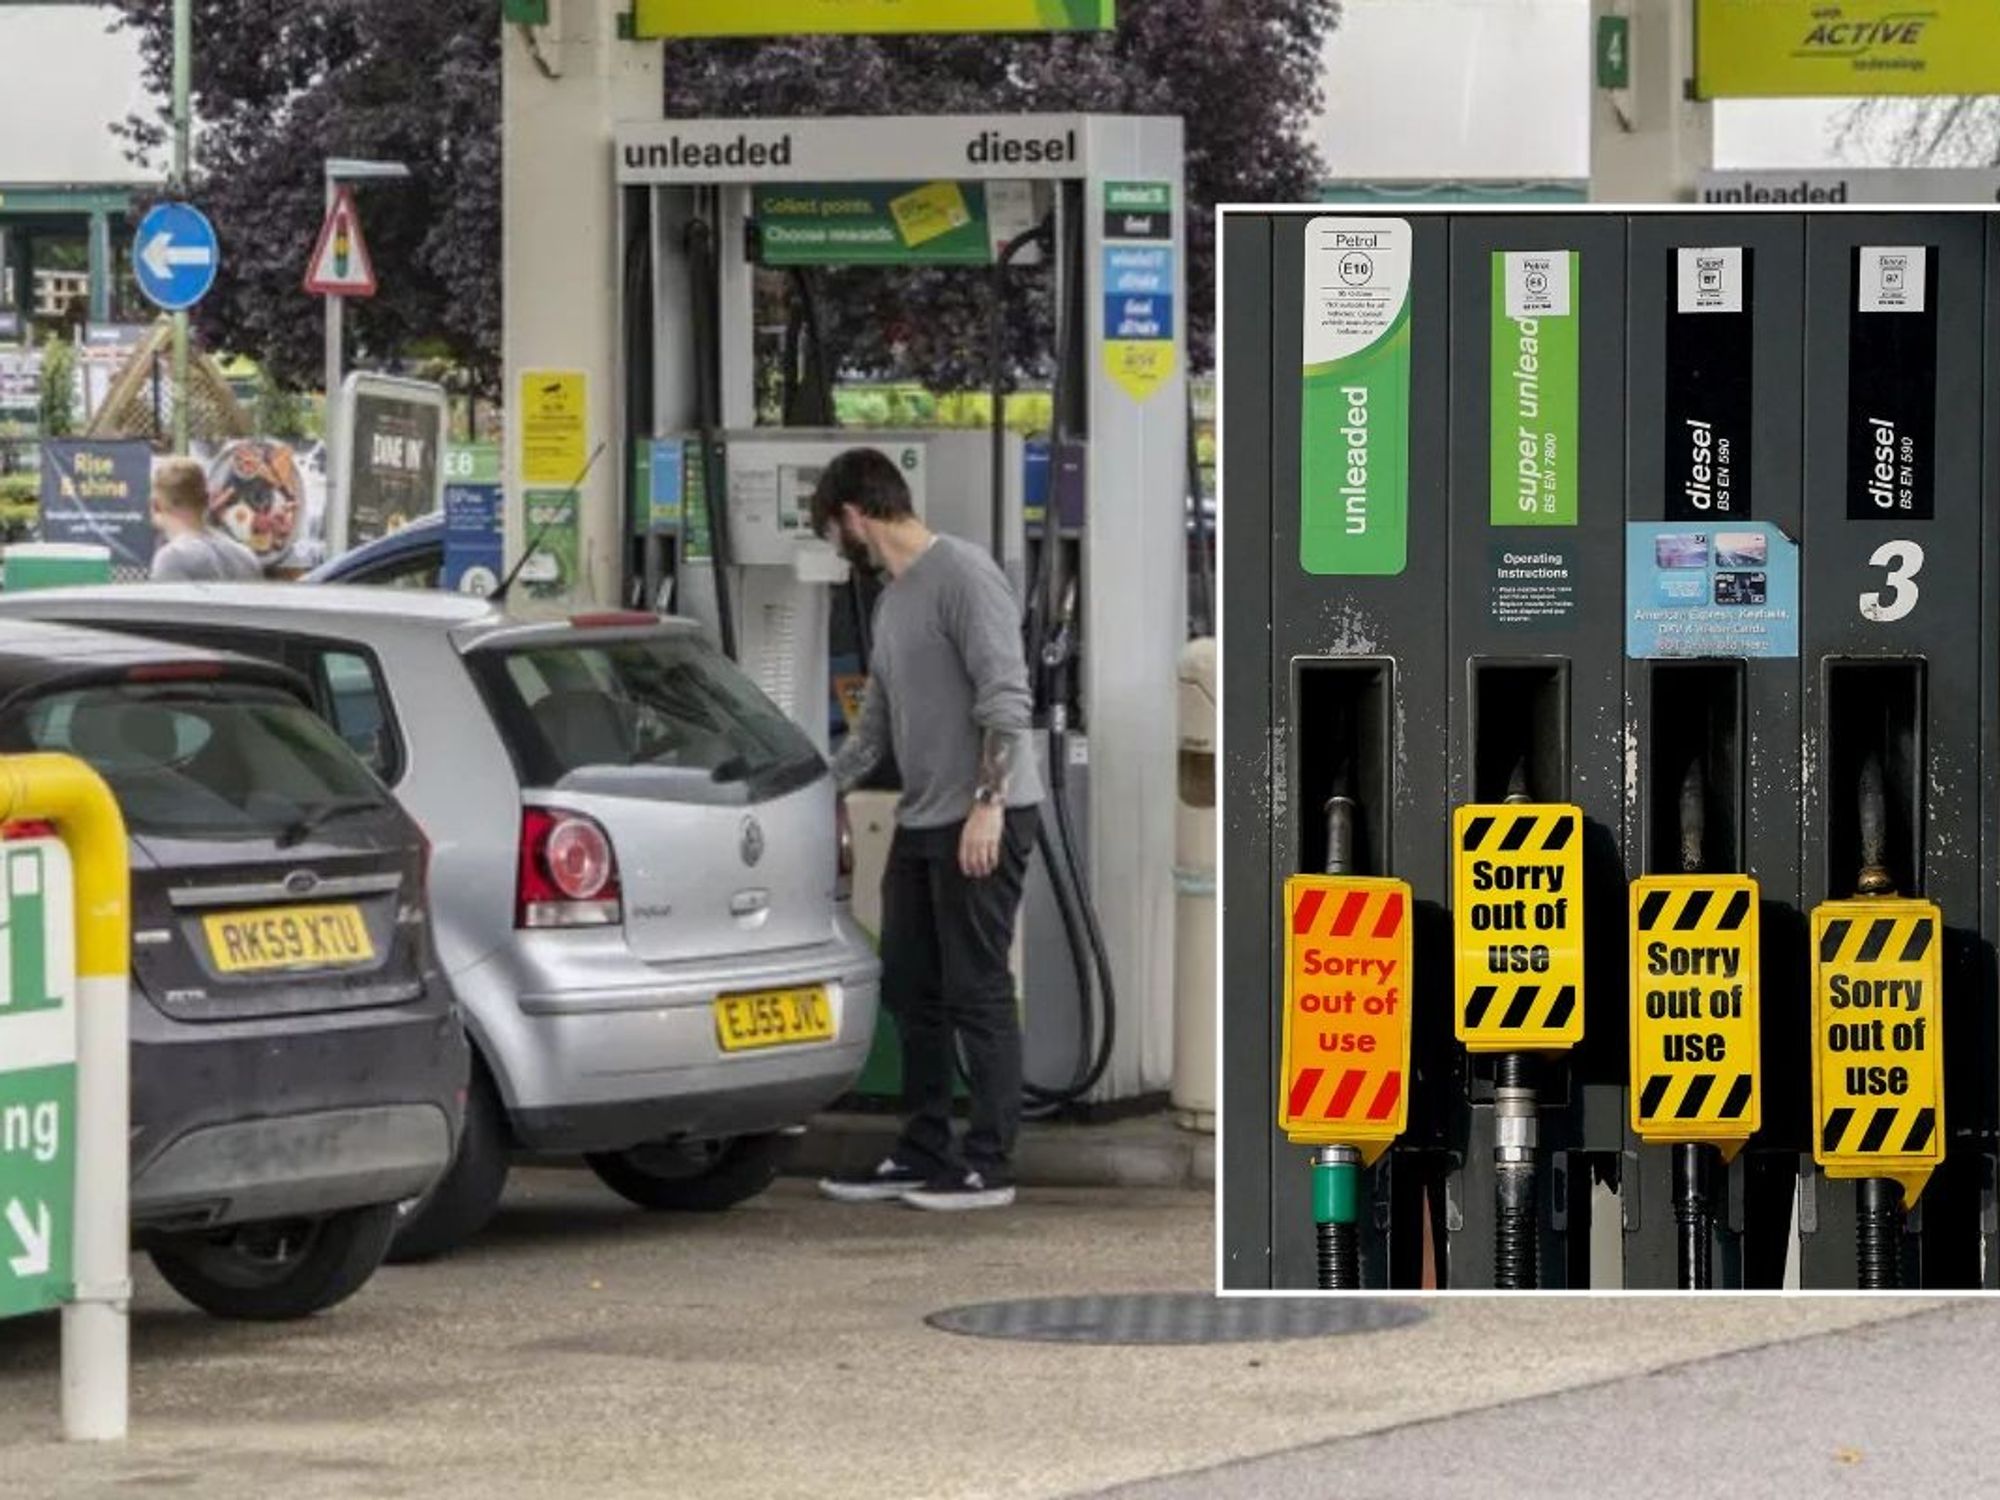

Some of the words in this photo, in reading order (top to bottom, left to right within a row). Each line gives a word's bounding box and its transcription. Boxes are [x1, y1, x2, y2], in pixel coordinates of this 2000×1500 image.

[1803, 22, 1925, 45] ACTIVE
[625, 135, 791, 168] unleaded
[967, 132, 1077, 163] diesel
[1705, 181, 1847, 203] unleaded
[1336, 234, 1377, 247] Petrol
[1344, 262, 1368, 275] E10
[74, 452, 114, 475] Rise
[901, 450, 918, 470] 6
[1339, 386, 1368, 534] unleaded
[1718, 438, 1730, 464] 590
[1868, 417, 1895, 509] diesel
[1901, 437, 1914, 463] 590
[1518, 425, 1542, 514] super
[1685, 419, 1711, 510] diesel
[1717, 466, 1730, 487] EN
[1901, 466, 1913, 487] EN
[80, 476, 128, 498] shine
[1544, 469, 1557, 489] EN
[1544, 494, 1556, 513] BS
[1717, 490, 1730, 511] BS
[1900, 488, 1913, 509] BS
[1497, 568, 1568, 578] Instructions
[1503, 553, 1563, 566] Operating
[1859, 539, 1925, 622] 3
[1473, 860, 1565, 893] Sorry
[1471, 900, 1527, 930] out
[1535, 898, 1568, 930] of
[222, 916, 304, 963] RK59
[303, 914, 360, 956] XTU
[1303, 948, 1397, 985] Sorry
[1488, 944, 1550, 974] use
[1647, 941, 1740, 979] Sorry
[1300, 991, 1356, 1014] out
[1363, 987, 1399, 1015] of
[1646, 986, 1702, 1019] out
[1709, 984, 1743, 1019] of
[1829, 973, 1923, 1012] Sorry
[725, 996, 785, 1039] EJ55
[1319, 1032, 1376, 1053] use
[1663, 1033, 1726, 1062] use
[1828, 1019, 1885, 1052] out
[1892, 1016, 1926, 1051] of
[1846, 1066, 1909, 1096] use
[4, 1101, 59, 1161] ng
